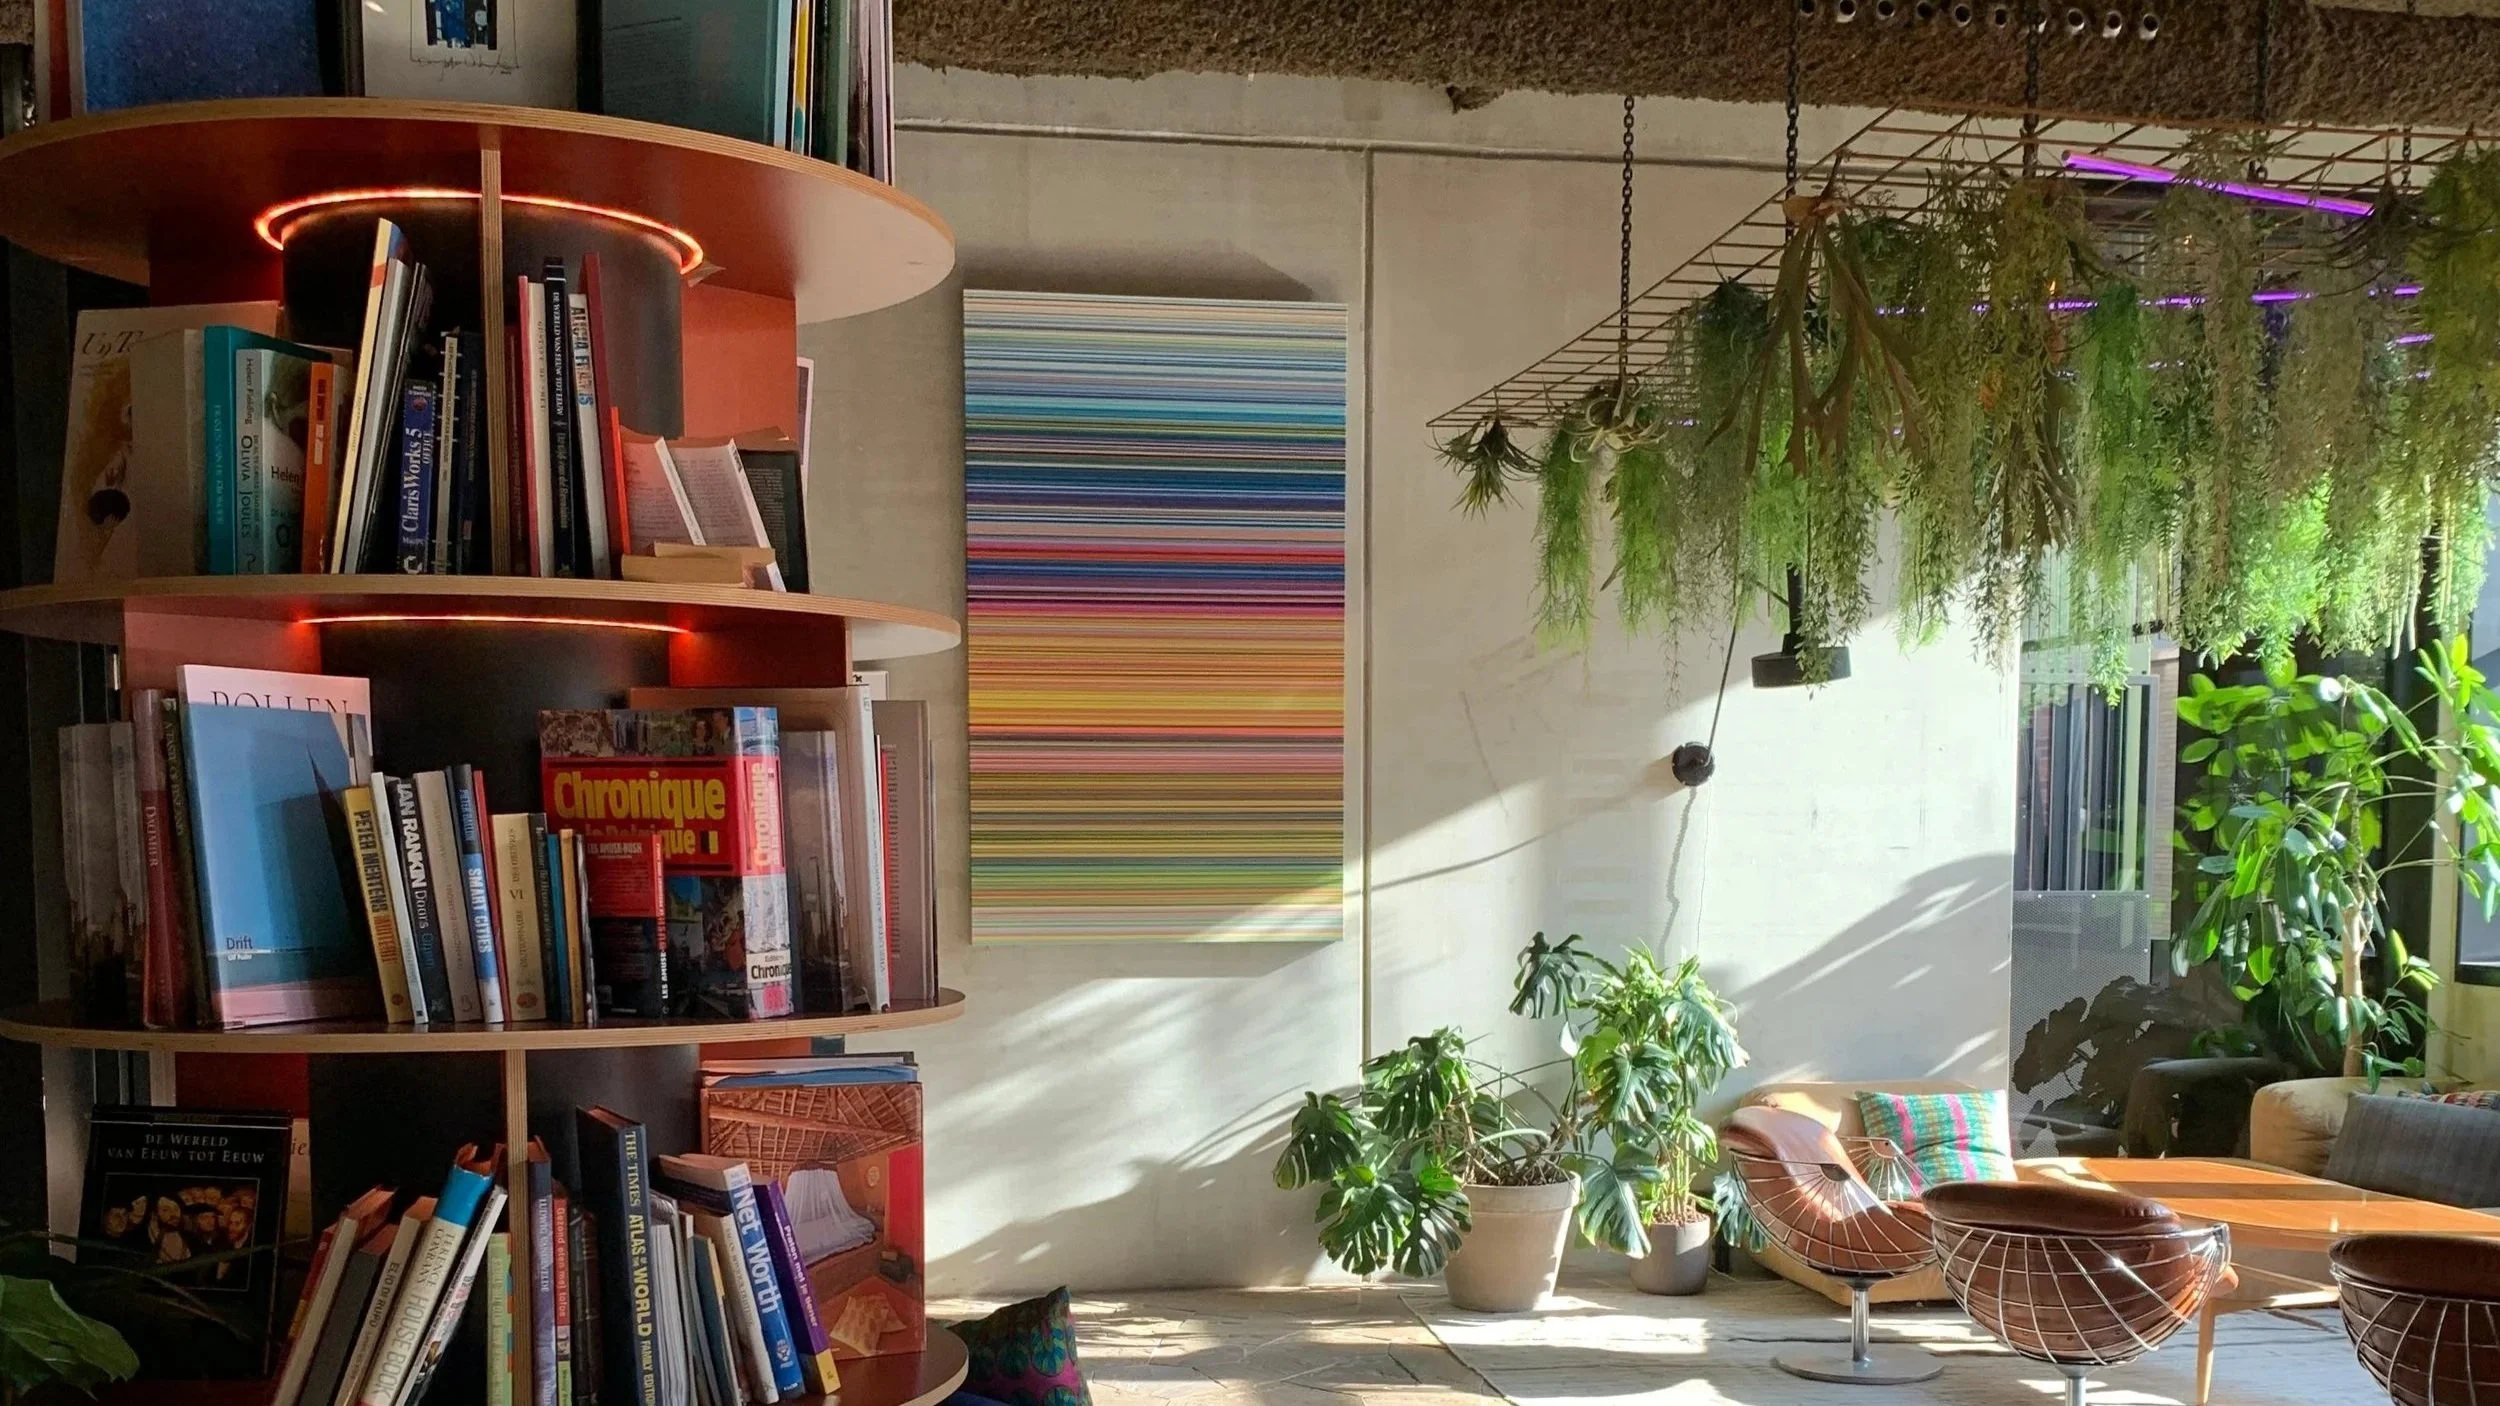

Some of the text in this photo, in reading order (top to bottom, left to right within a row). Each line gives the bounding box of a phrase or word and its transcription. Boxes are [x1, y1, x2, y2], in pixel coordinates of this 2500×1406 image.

[553, 291, 559, 301] DE
[246, 357, 254, 386] Helen
[554, 352, 562, 375] EEUW
[405, 428, 422, 438] 5
[240, 435, 253, 539] OLIVIA JOULES
[402, 441, 421, 532] ClarisWorks
[396, 783, 415, 816] IAN
[554, 770, 726, 828] Chronique
[751, 762, 771, 867] Chronique
[354, 810, 377, 850] PETER
[402, 818, 428, 888] RANKIN
[362, 853, 388, 913] MERTENS
[414, 890, 430, 929] Doors
[468, 867, 493, 954] SMART CITIES
[226, 936, 254, 950] Drift
[661, 983, 669, 999] LES
[108, 1147, 265, 1164] VAN EEUW TOT EEUW
[145, 1132, 229, 1147] DE WERELD
[625, 1131, 642, 1207] THE TIMES
[557, 1206, 566, 1245] Gezond
[629, 1214, 646, 1256] ATLAS
[428, 1233, 455, 1287] TERENCE
[557, 1246, 566, 1268] eten
[734, 1186, 782, 1314] Net Worth
[369, 1262, 400, 1329] ELIO DI RUPO
[558, 1270, 567, 1288] met
[784, 1225, 818, 1327] Praten met je tiener
[634, 1266, 653, 1337] WORLD
[373, 1294, 430, 1399] HOUSE BOOK
[640, 1340, 653, 1371] FAMILY
